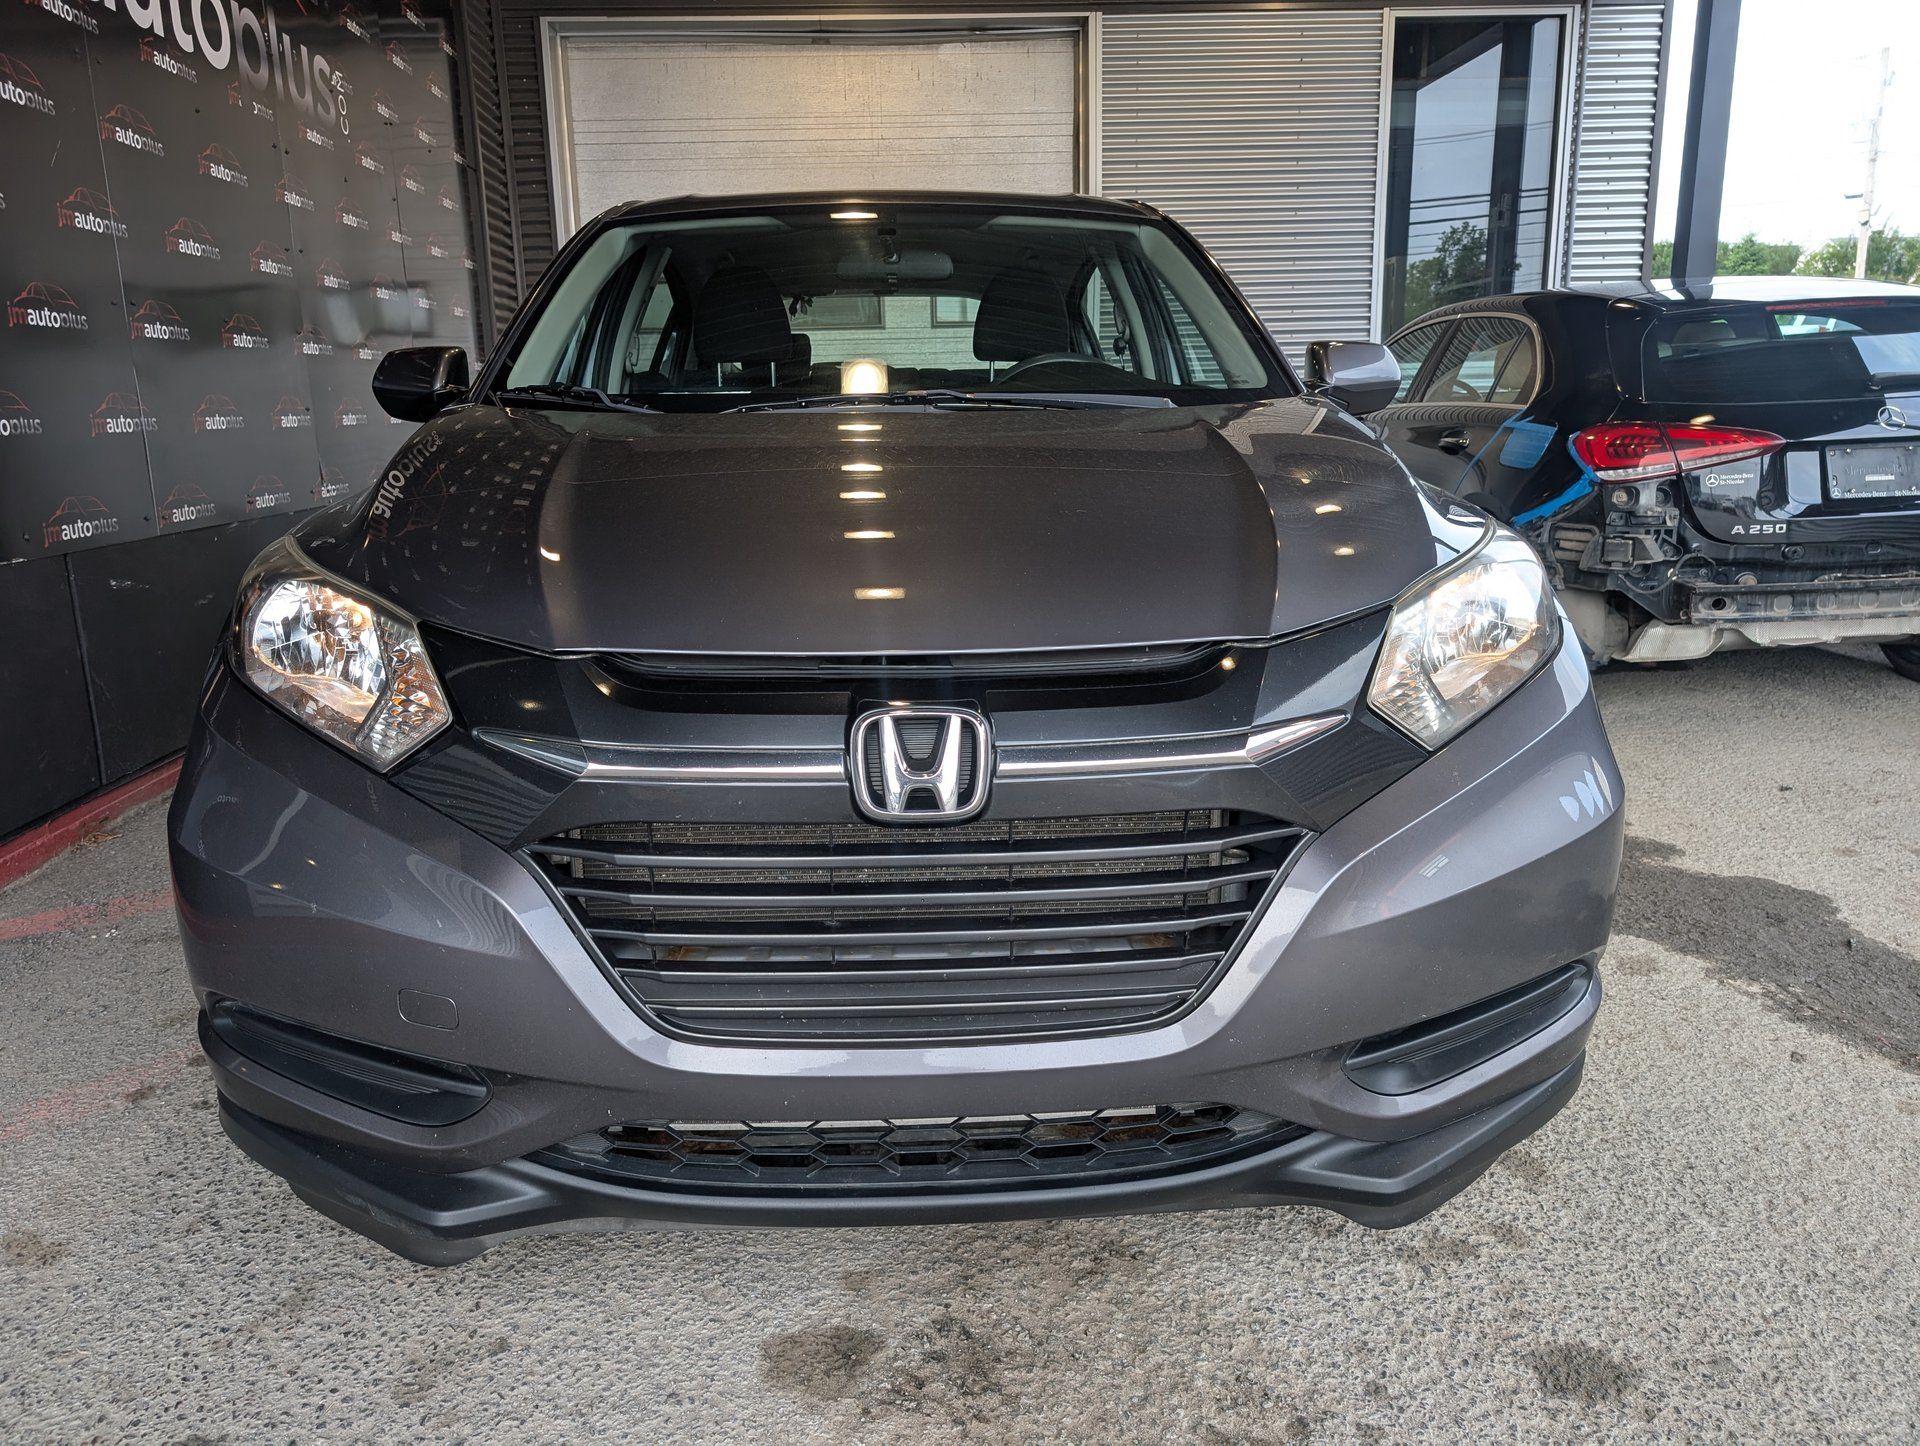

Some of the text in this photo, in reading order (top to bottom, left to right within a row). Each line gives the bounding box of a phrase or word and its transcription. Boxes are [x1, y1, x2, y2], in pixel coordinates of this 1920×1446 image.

[25, 0, 99, 35] autoplus
[1731, 523, 1787, 535] A 250
